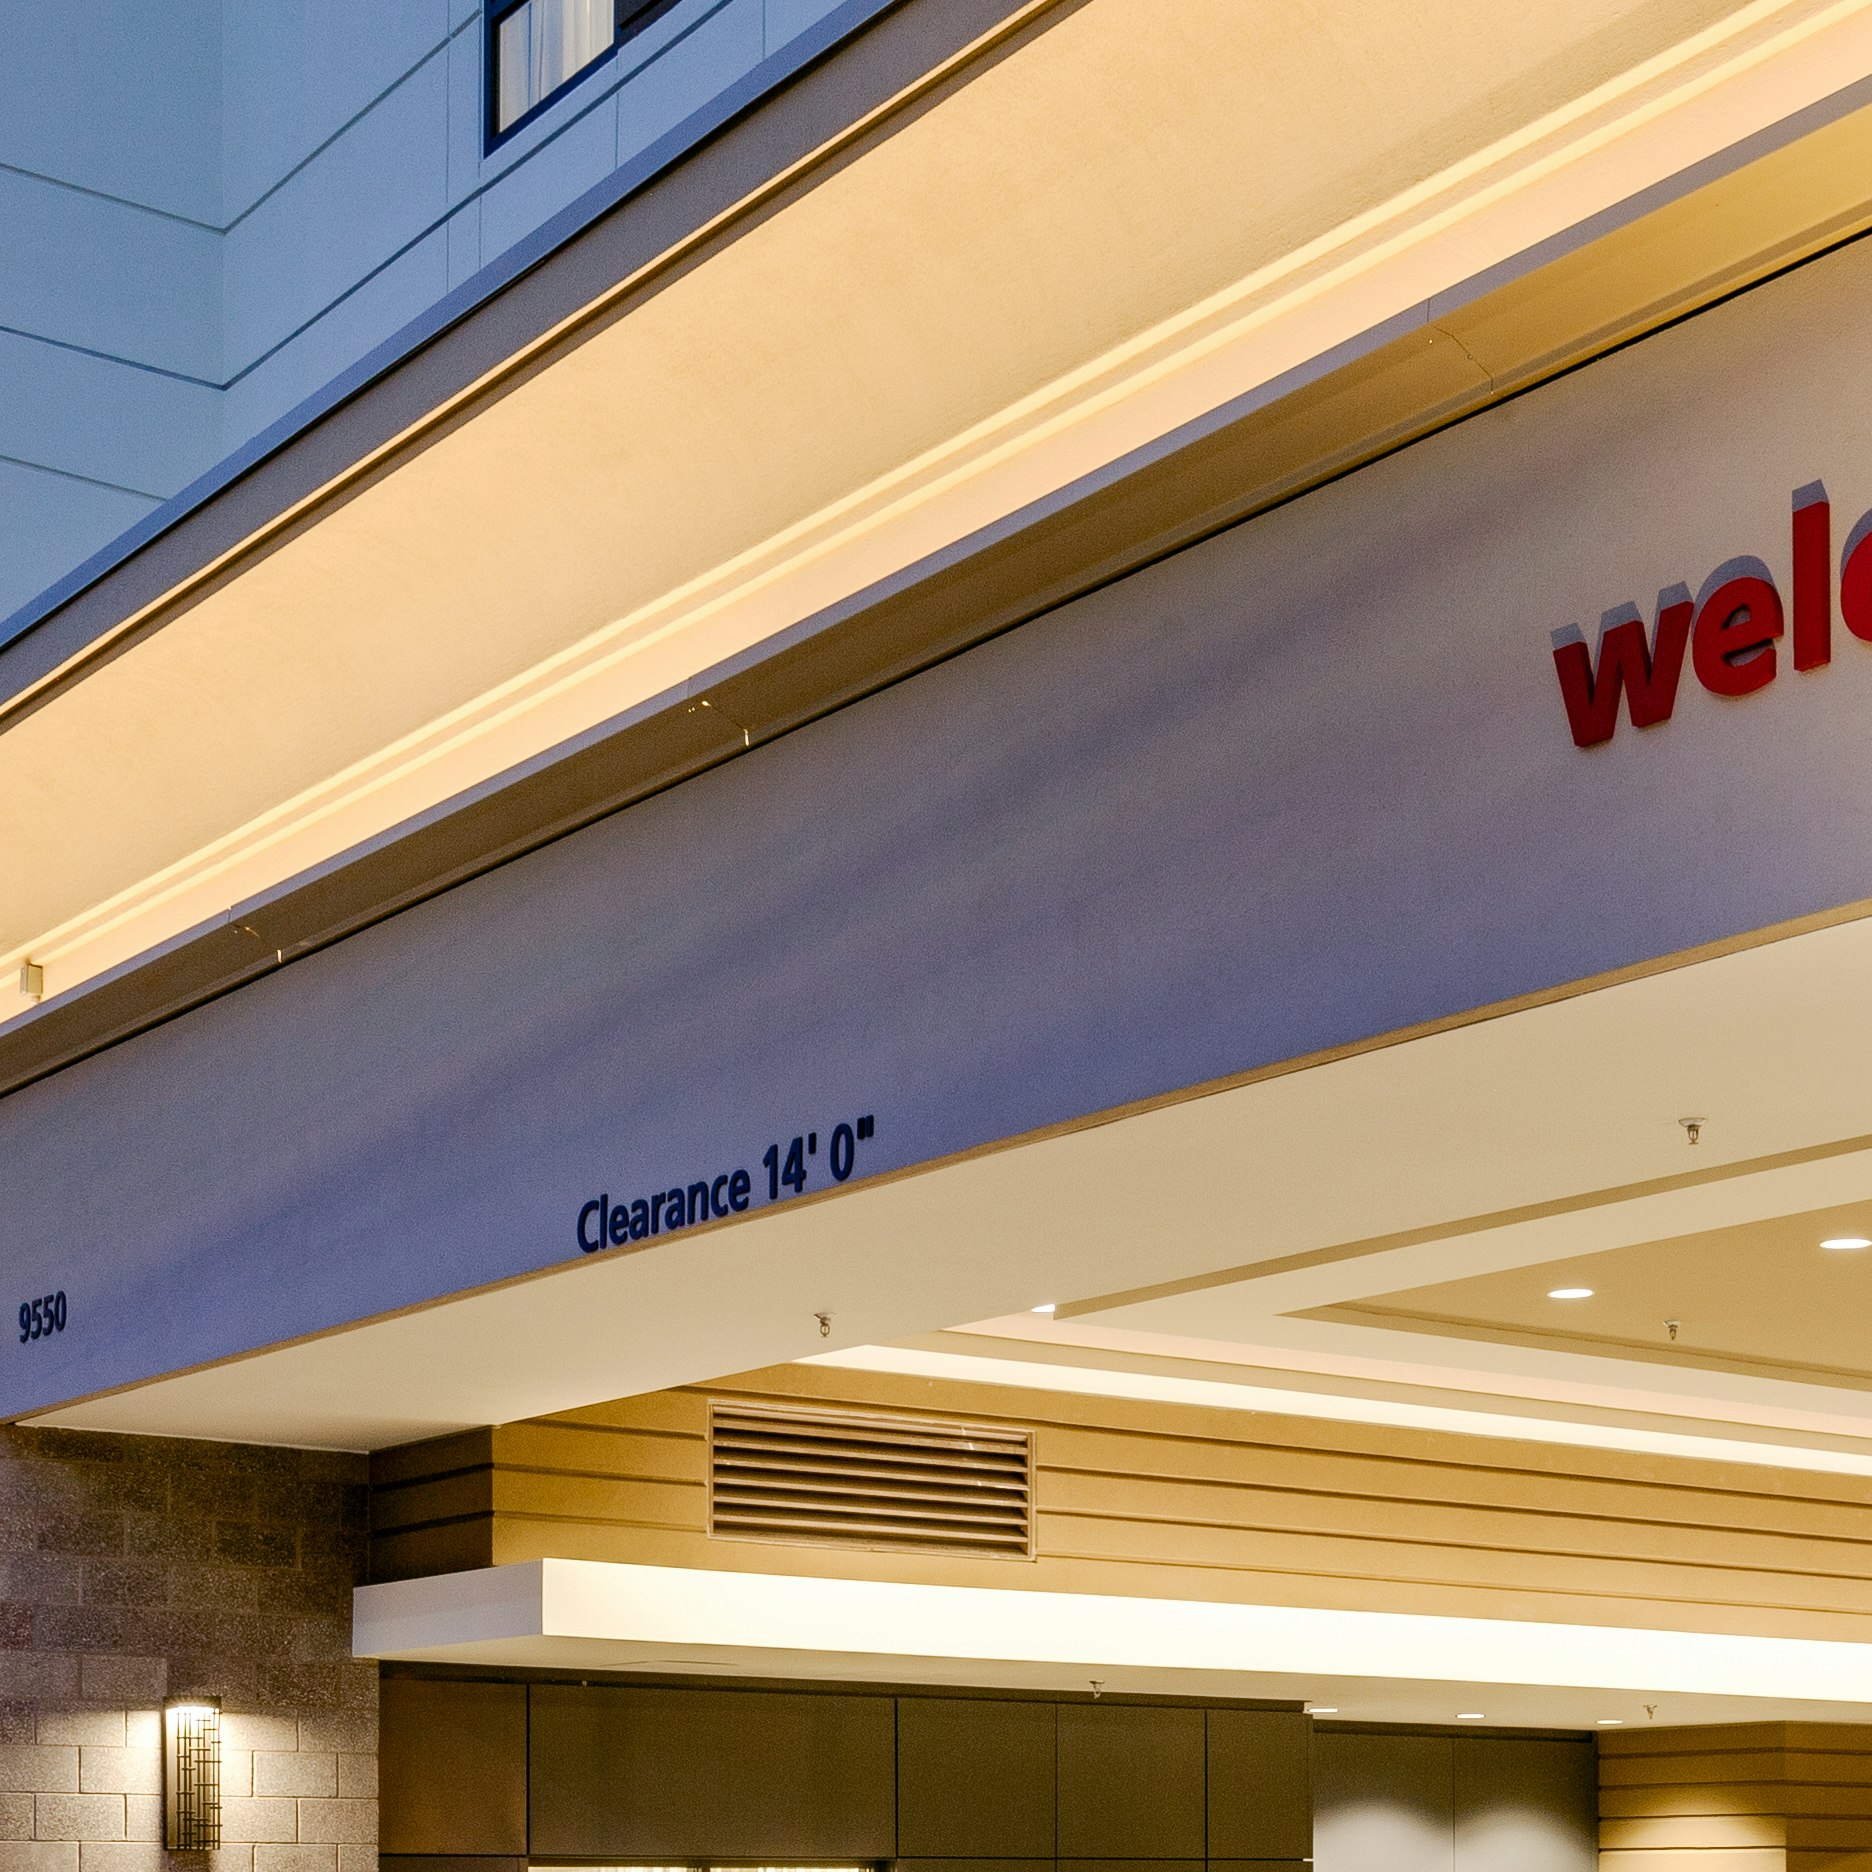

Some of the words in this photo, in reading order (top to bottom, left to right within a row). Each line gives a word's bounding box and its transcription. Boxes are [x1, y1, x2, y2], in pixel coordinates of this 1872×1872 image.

[577, 1169, 751, 1254] Clearance
[762, 1132, 817, 1200] 14'
[830, 1114, 875, 1182] 0"
[19, 1290, 67, 1344] 9550
